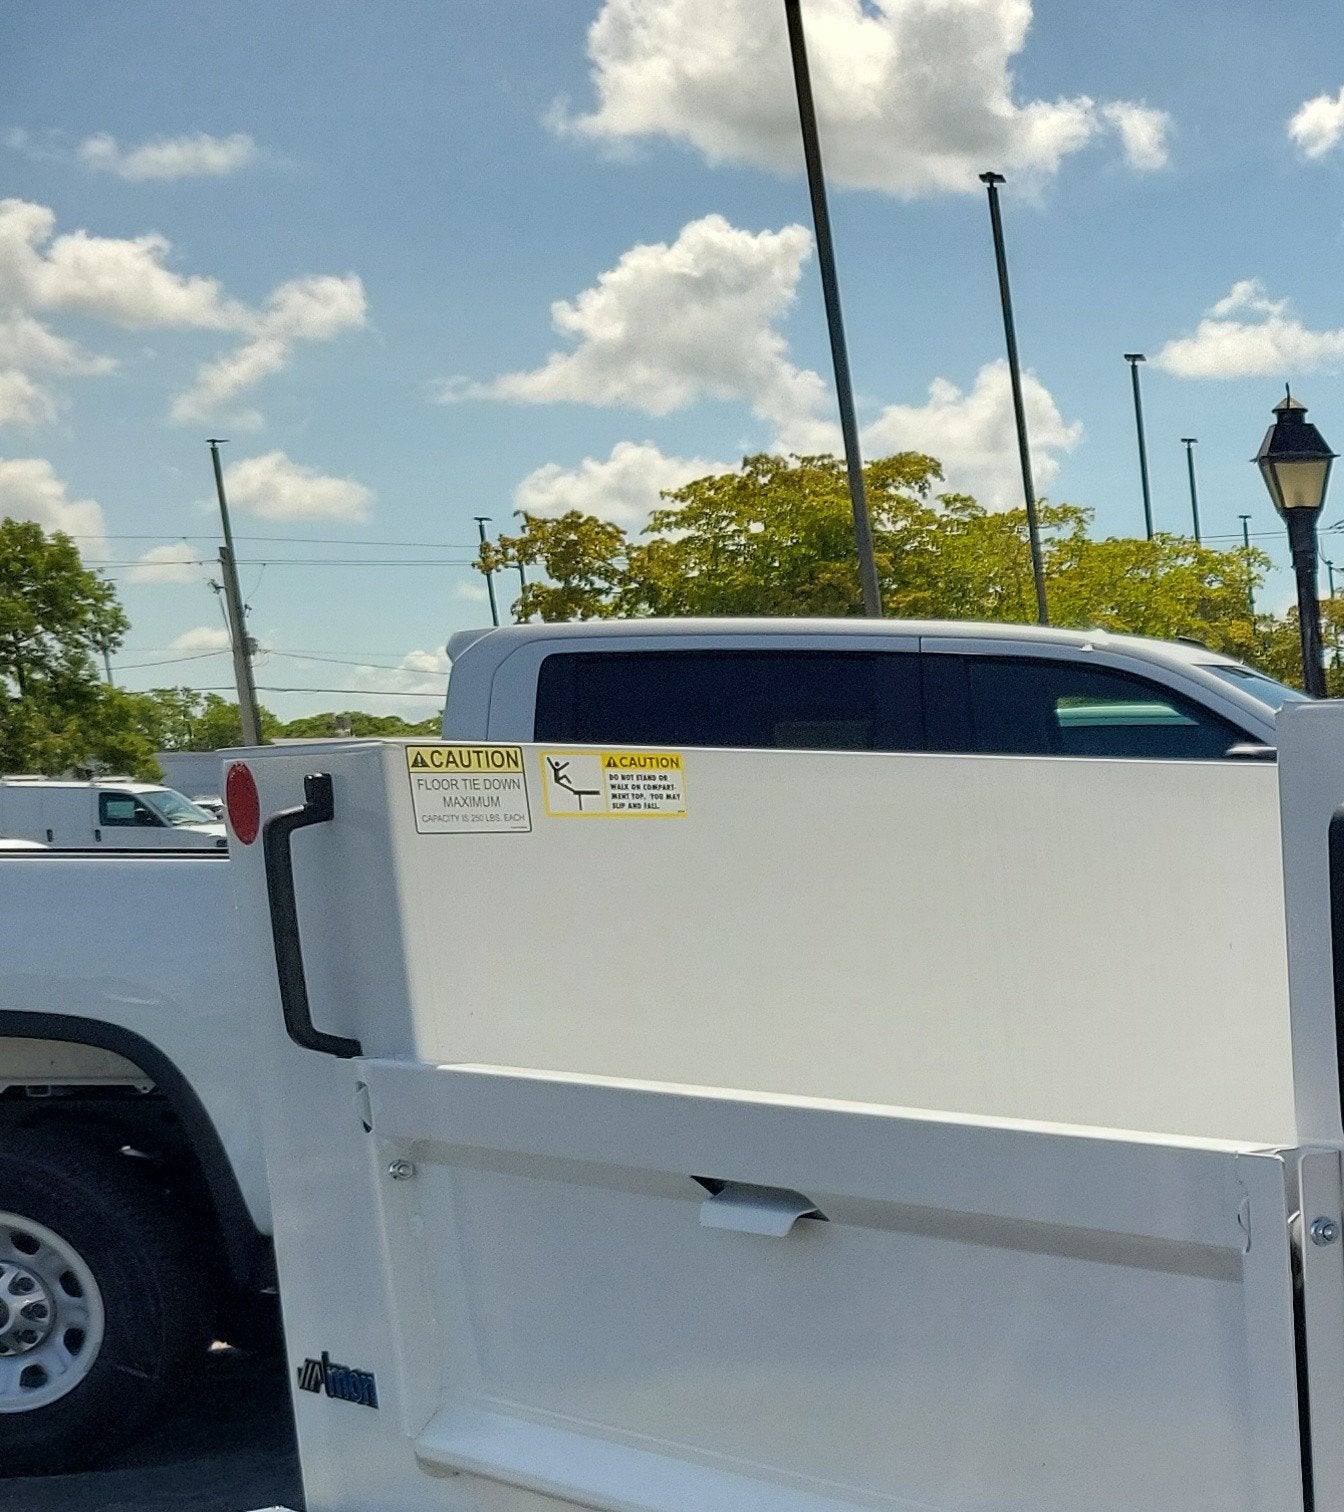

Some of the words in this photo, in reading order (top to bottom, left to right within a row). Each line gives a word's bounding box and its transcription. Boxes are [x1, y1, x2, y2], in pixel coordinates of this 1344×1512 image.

[430, 750, 519, 768] CAUTION
[619, 756, 680, 768] CAUTION
[417, 778, 459, 790] FLOOR
[461, 778, 481, 790] TIE
[484, 778, 521, 790] DOWN
[443, 796, 501, 808] MAXIMUM
[422, 814, 459, 822] CAPACITY
[461, 814, 469, 822] IS
[504, 813, 525, 822] EACH
